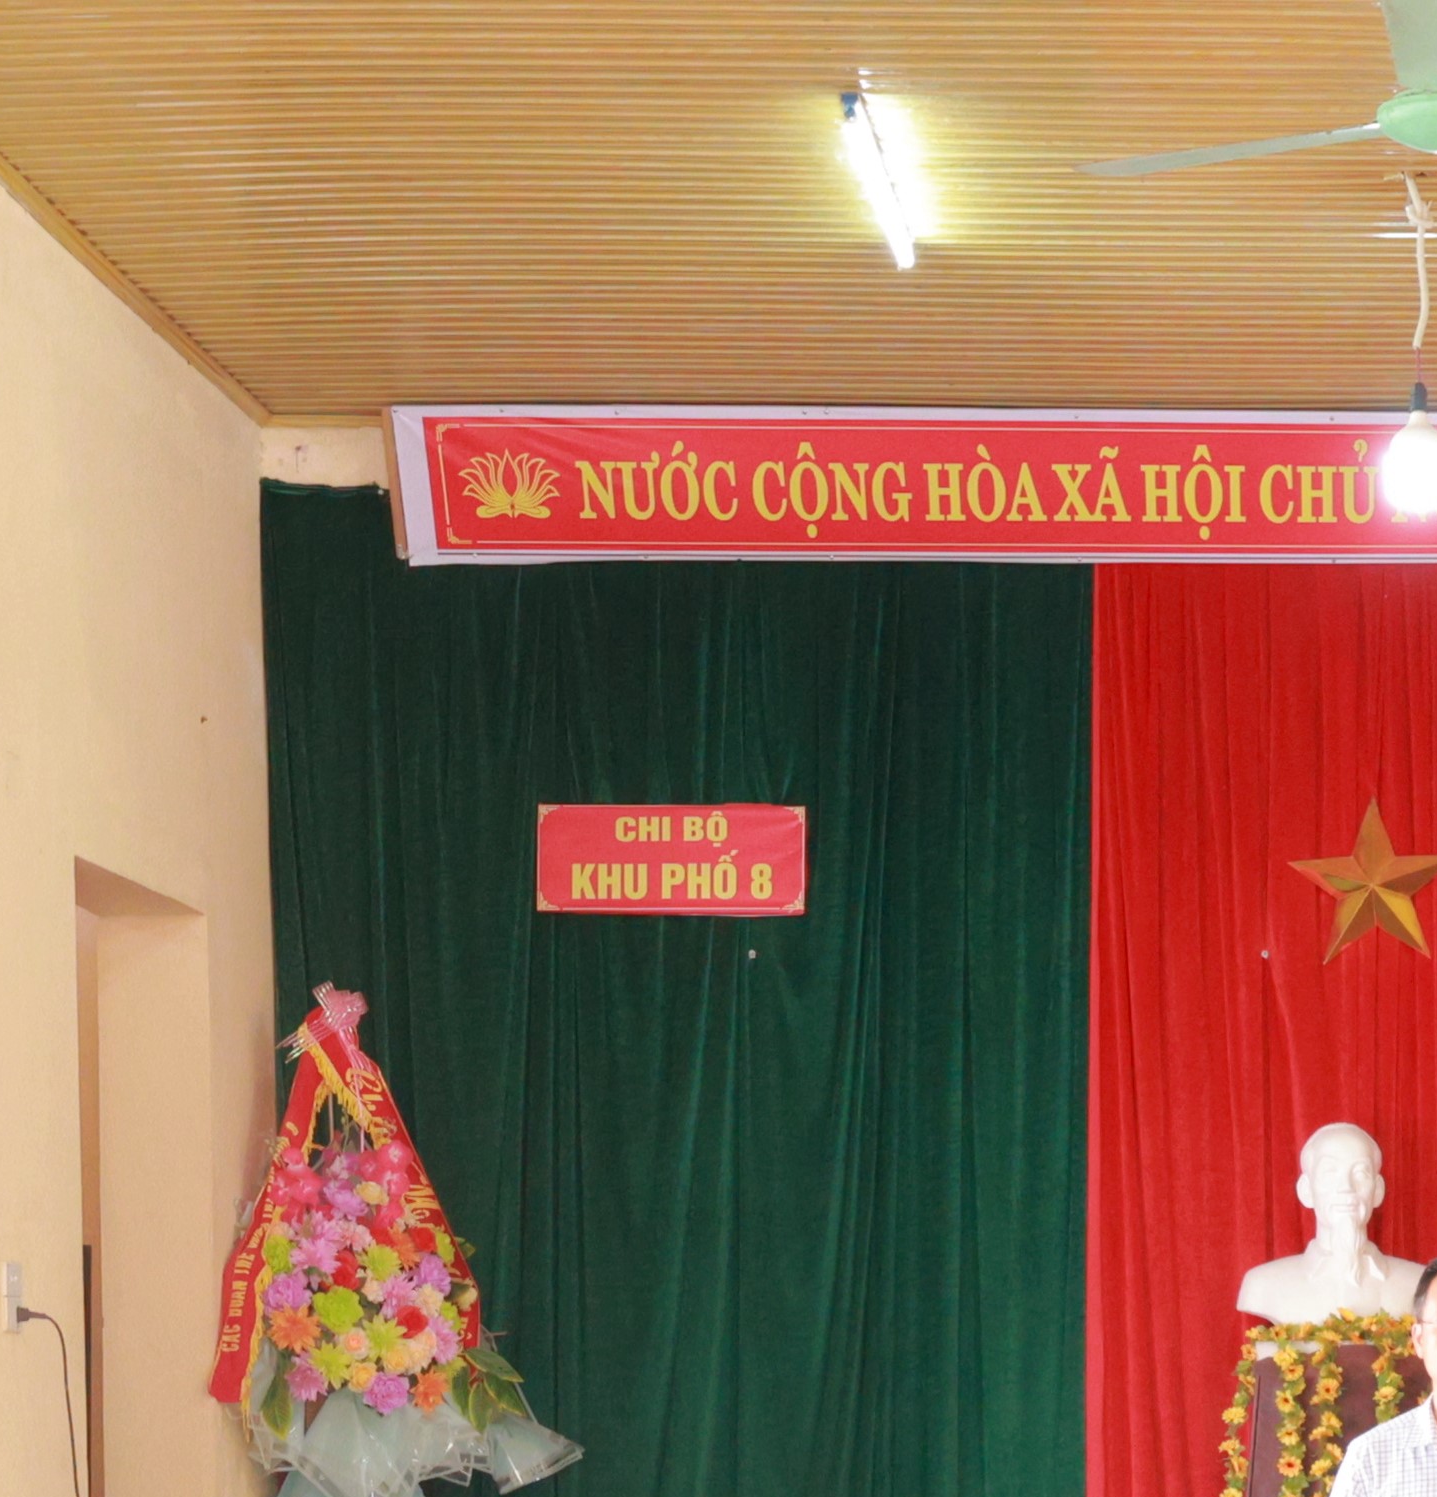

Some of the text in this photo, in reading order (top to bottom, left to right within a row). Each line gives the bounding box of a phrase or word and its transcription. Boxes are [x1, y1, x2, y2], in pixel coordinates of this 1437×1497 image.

[577, 441, 740, 521] NƯỚC
[751, 441, 912, 539] CỘNG
[923, 444, 1047, 522] HÒA
[1052, 446, 1131, 521] XÃ
[1141, 445, 1246, 541] HỘI
[1259, 438, 1379, 524] CHỦ
[616, 811, 727, 847] CHI BỘ
[572, 850, 772, 899] KHU PHỐ 8
